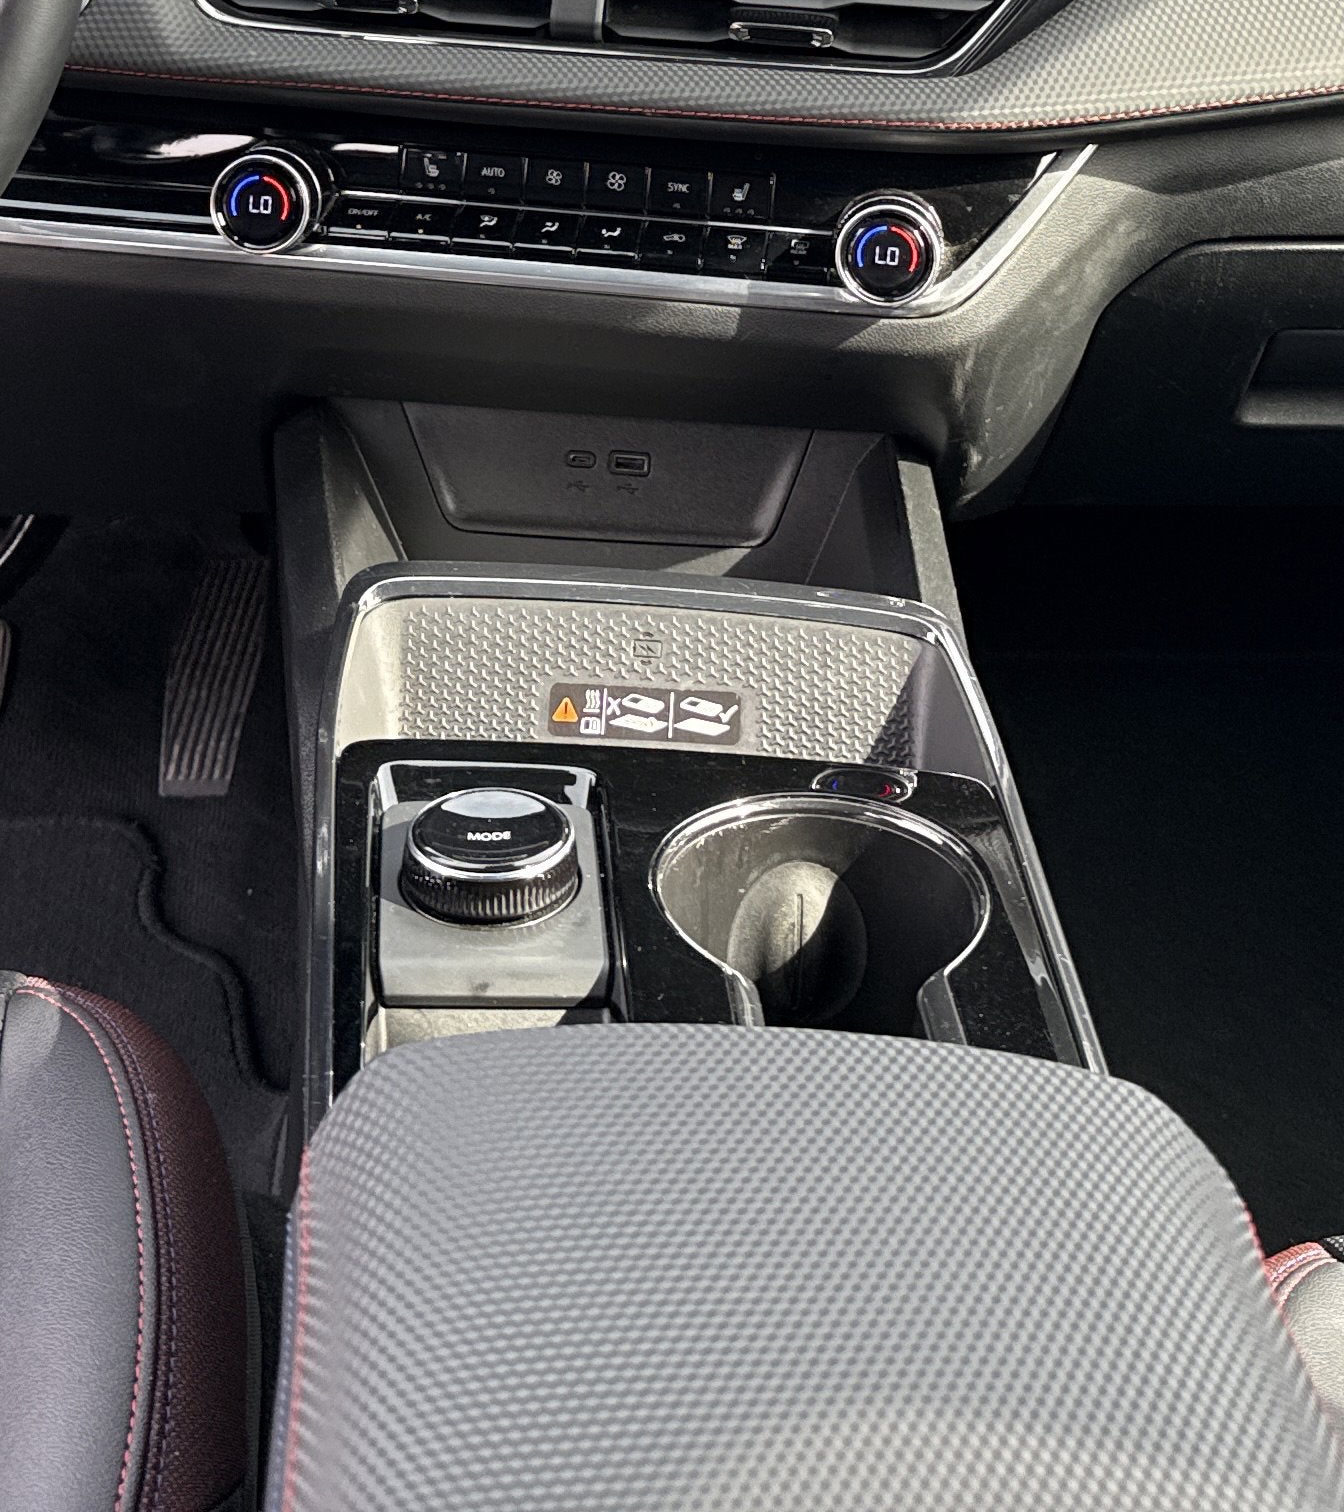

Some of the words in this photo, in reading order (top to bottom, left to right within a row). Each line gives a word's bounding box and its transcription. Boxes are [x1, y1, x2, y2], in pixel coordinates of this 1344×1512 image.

[481, 167, 506, 178] AUTO
[667, 182, 691, 194] SYNC
[249, 196, 273, 215] LO
[874, 245, 900, 266] LO
[466, 830, 512, 842] MODE
